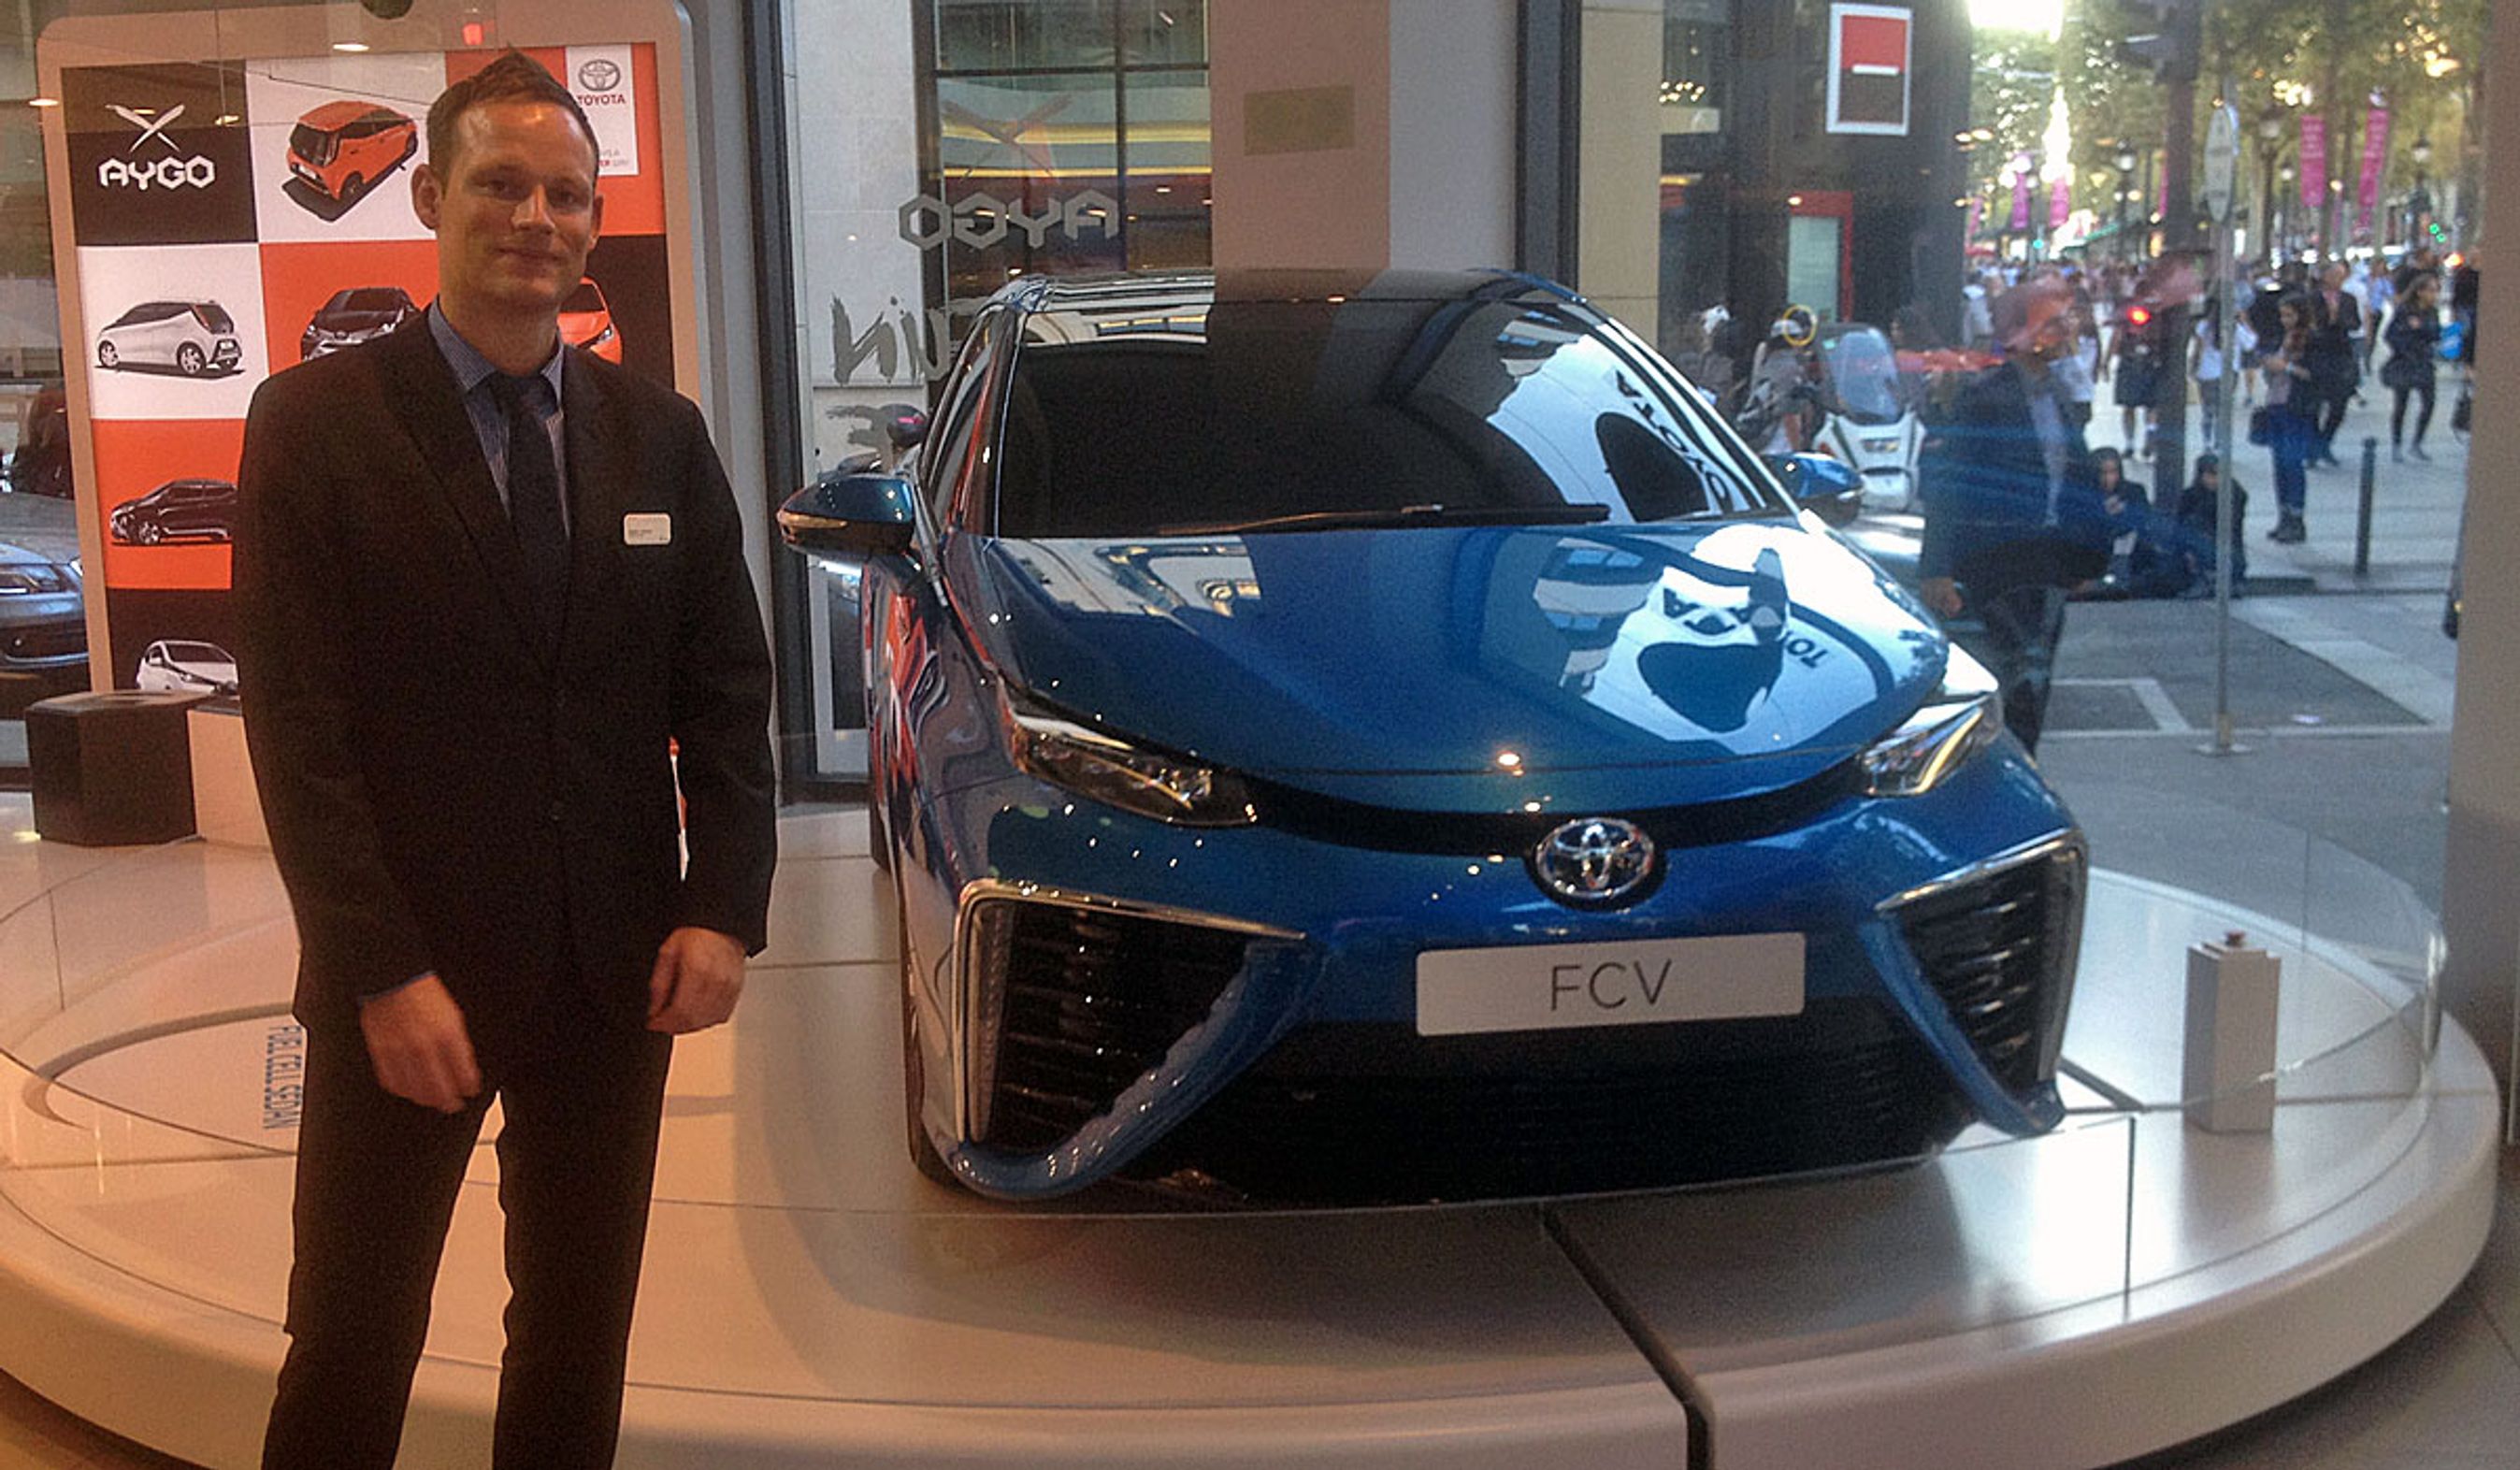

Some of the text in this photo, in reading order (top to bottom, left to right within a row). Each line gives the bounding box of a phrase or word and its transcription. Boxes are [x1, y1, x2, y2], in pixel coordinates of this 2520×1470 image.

[577, 94, 626, 106] TOYOTA
[98, 154, 216, 191] AYGO
[1551, 958, 1672, 1011] FCV
[263, 1025, 303, 1130] FUEL CELL SEDAN
